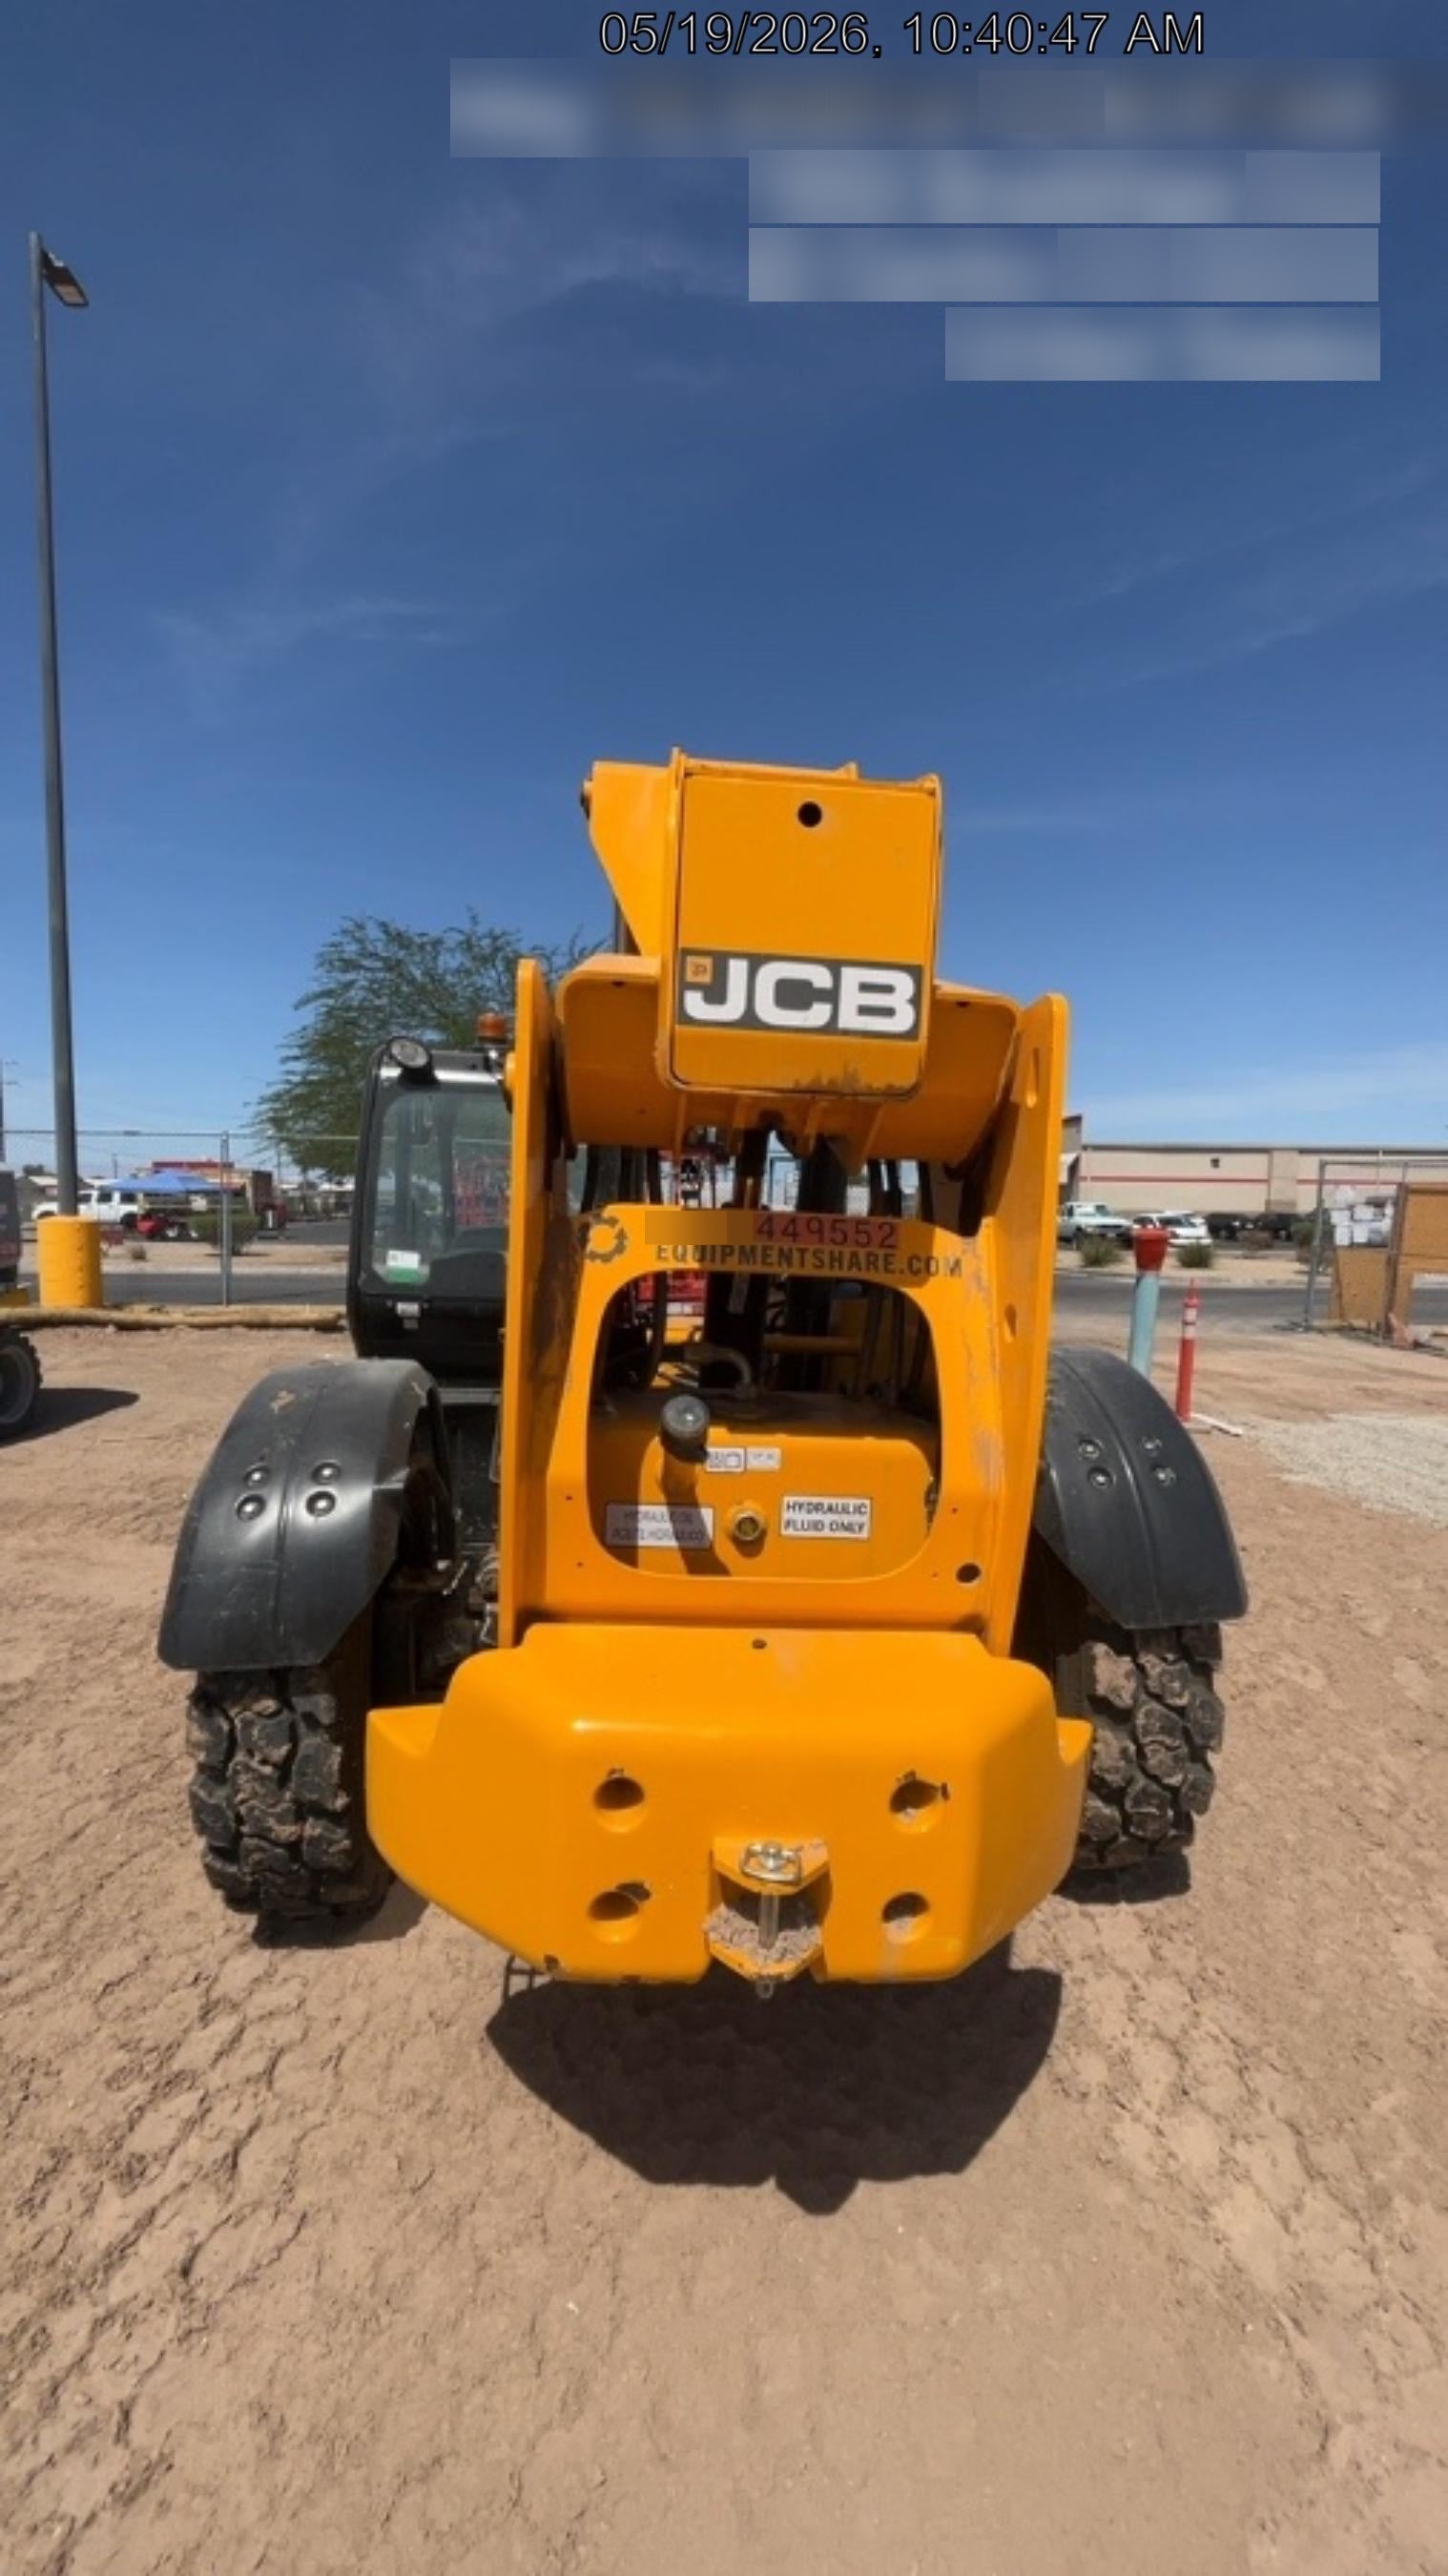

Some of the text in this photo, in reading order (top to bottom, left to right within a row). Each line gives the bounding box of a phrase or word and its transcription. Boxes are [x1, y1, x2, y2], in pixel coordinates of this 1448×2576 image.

[683, 957, 917, 1034] JCB
[756, 1215, 898, 1249] 449552
[655, 1244, 963, 1278] EQUIPMENTSHARE.COM
[784, 1517, 865, 1534] FLUID ONLY
[786, 1500, 867, 1517] HYDRAULIC
